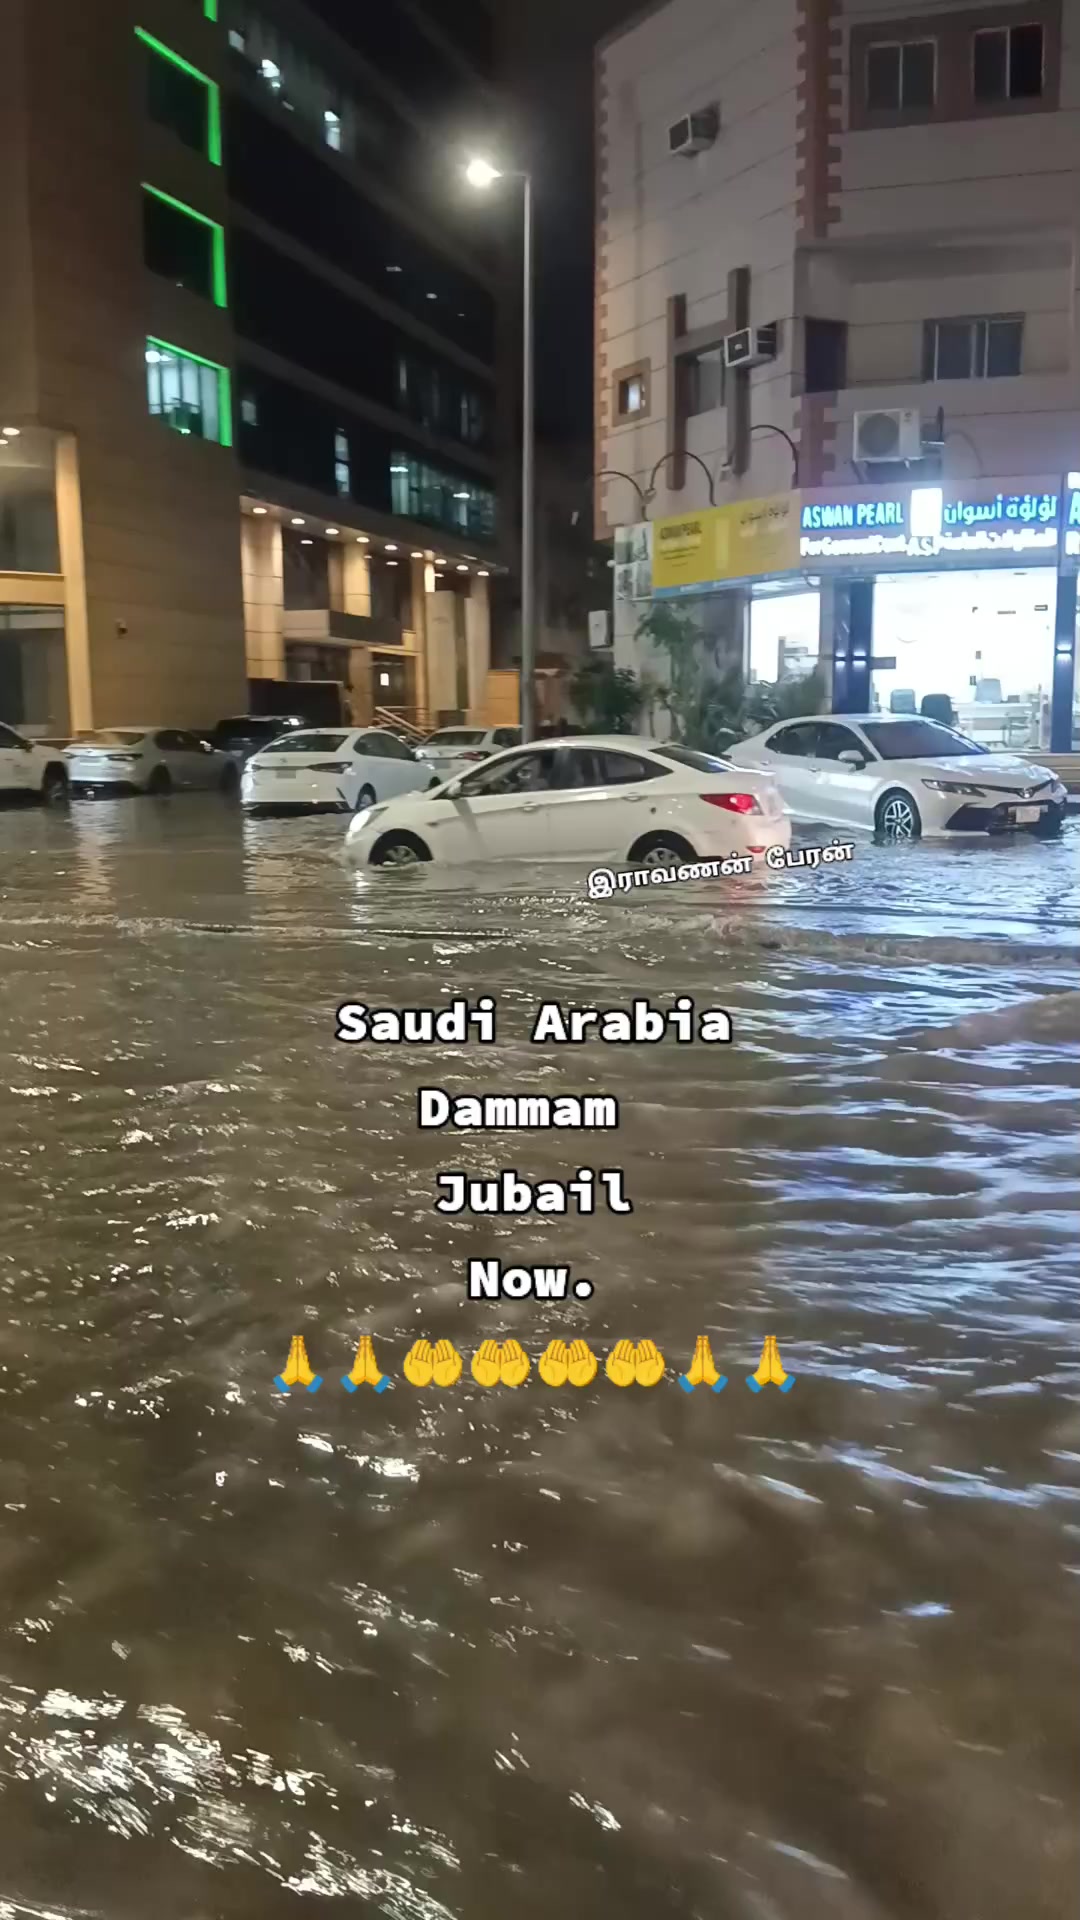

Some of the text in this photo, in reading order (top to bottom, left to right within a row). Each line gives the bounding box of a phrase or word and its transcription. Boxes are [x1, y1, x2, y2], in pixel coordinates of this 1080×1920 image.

[802, 504, 853, 528] ASWAN
[857, 502, 904, 526] PEARL
[943, 493, 1057, 524] لؤلؤة أسوان
